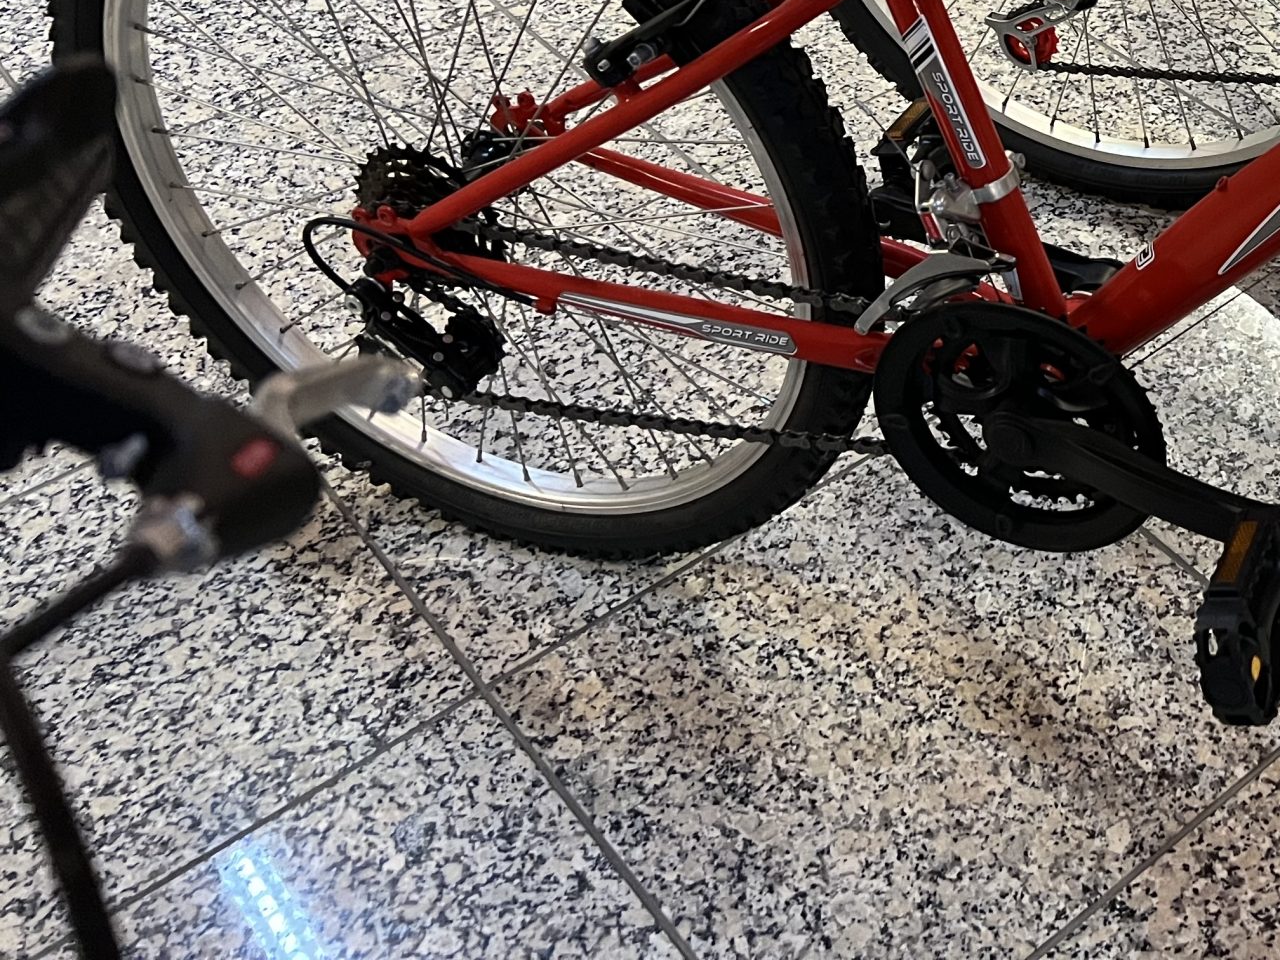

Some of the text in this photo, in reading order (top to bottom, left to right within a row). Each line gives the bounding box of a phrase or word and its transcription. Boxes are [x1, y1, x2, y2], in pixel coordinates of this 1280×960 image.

[931, 71, 980, 162] SPORT RIDE
[701, 323, 790, 347] SPORT RIDE
